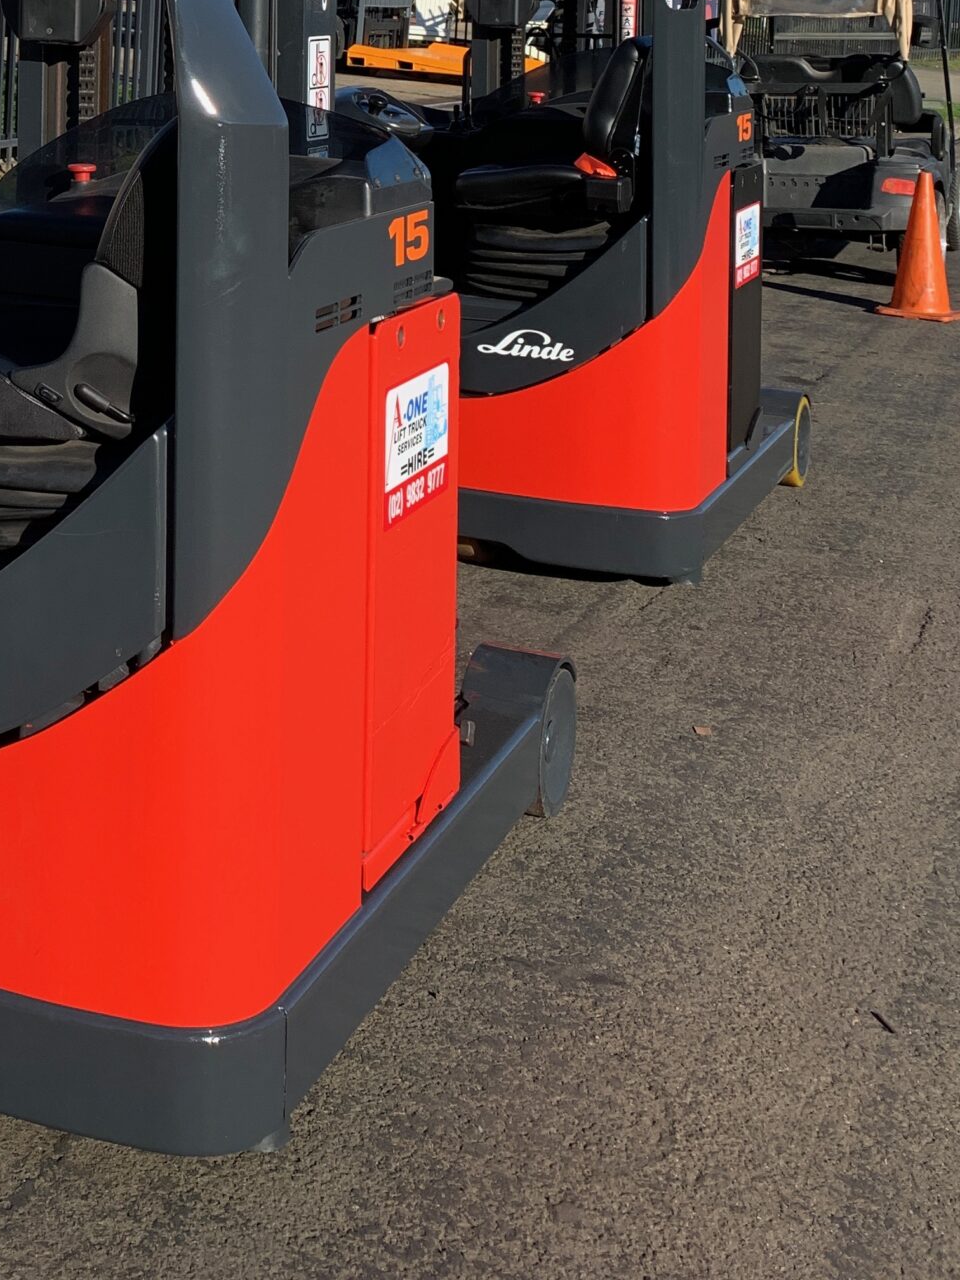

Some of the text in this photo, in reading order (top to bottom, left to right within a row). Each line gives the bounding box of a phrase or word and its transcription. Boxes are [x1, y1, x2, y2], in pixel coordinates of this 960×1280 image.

[737, 113, 751, 142] 15
[388, 209, 430, 267] 15
[477, 329, 574, 362] Linde
[393, 415, 427, 444] LIFT TRUCK
[397, 432, 423, 456] SERVICES
[388, 463, 445, 524] (02) 9832 9777
